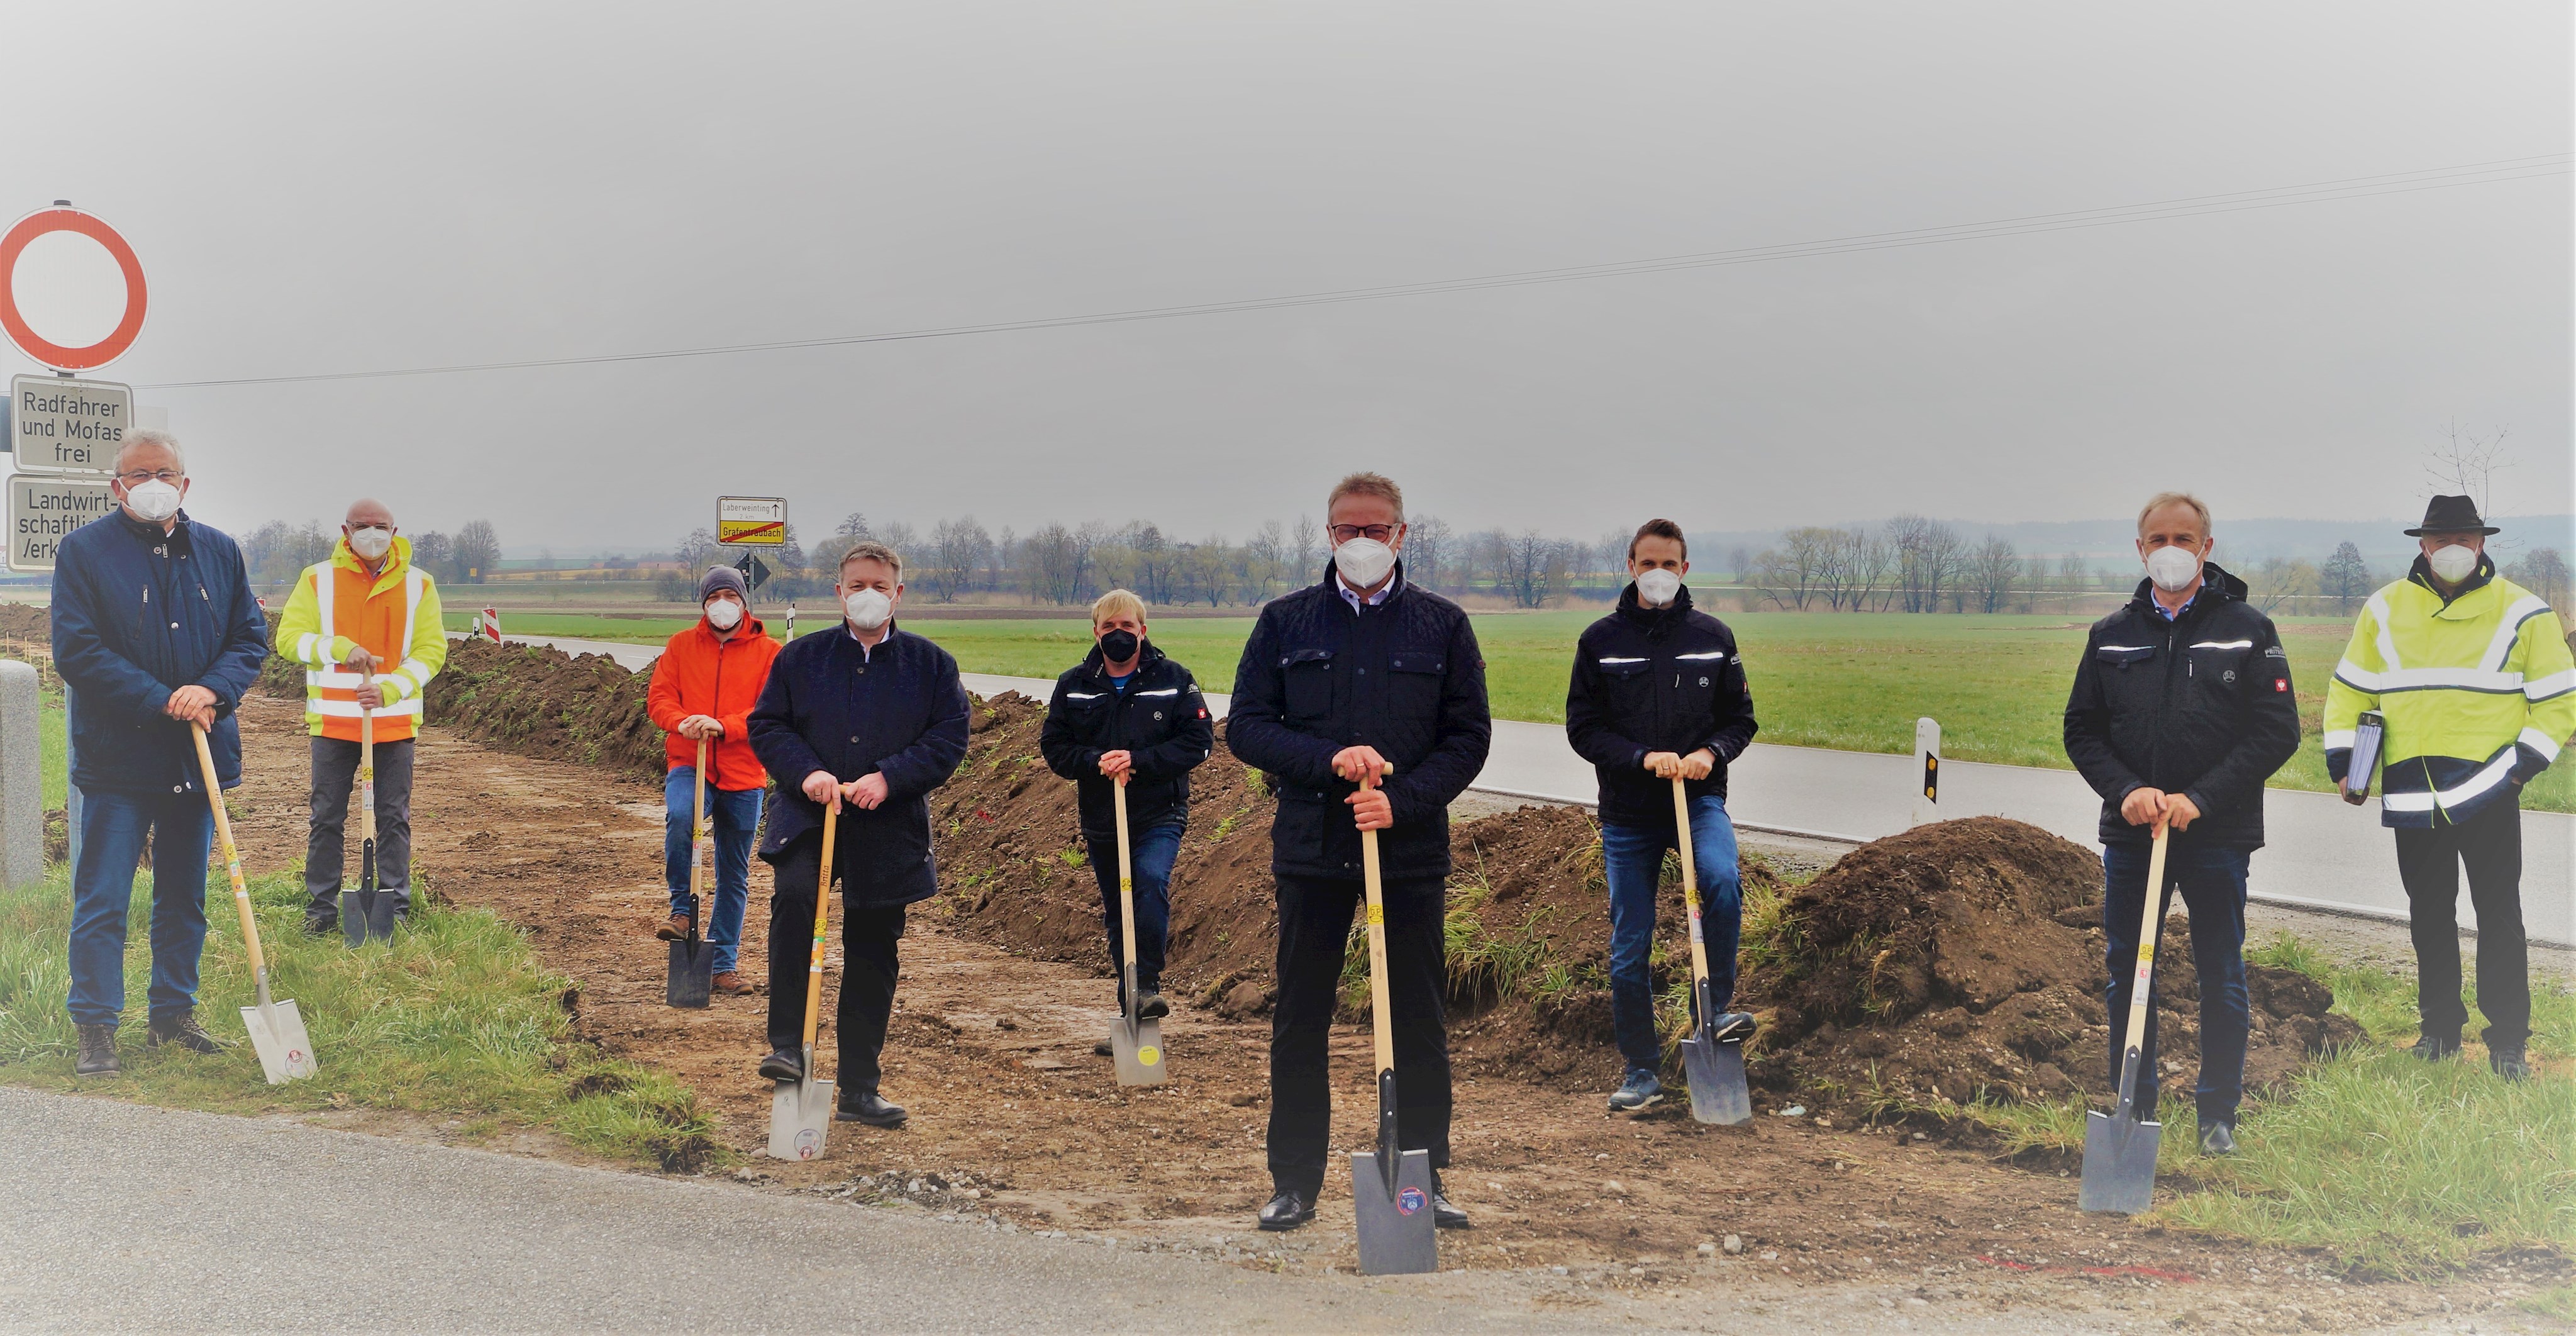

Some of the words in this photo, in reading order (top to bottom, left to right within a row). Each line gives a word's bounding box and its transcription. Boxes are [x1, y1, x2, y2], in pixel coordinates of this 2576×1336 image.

[24, 391, 119, 417] Radfahrer
[23, 418, 55, 437] und
[65, 419, 122, 441] Mofas
[55, 442, 91, 462] frei
[29, 489, 118, 511] Landwirt-
[723, 503, 770, 514] Laberweinting
[723, 527, 780, 537] Grafentraubach
[820, 866, 829, 887] Britta
